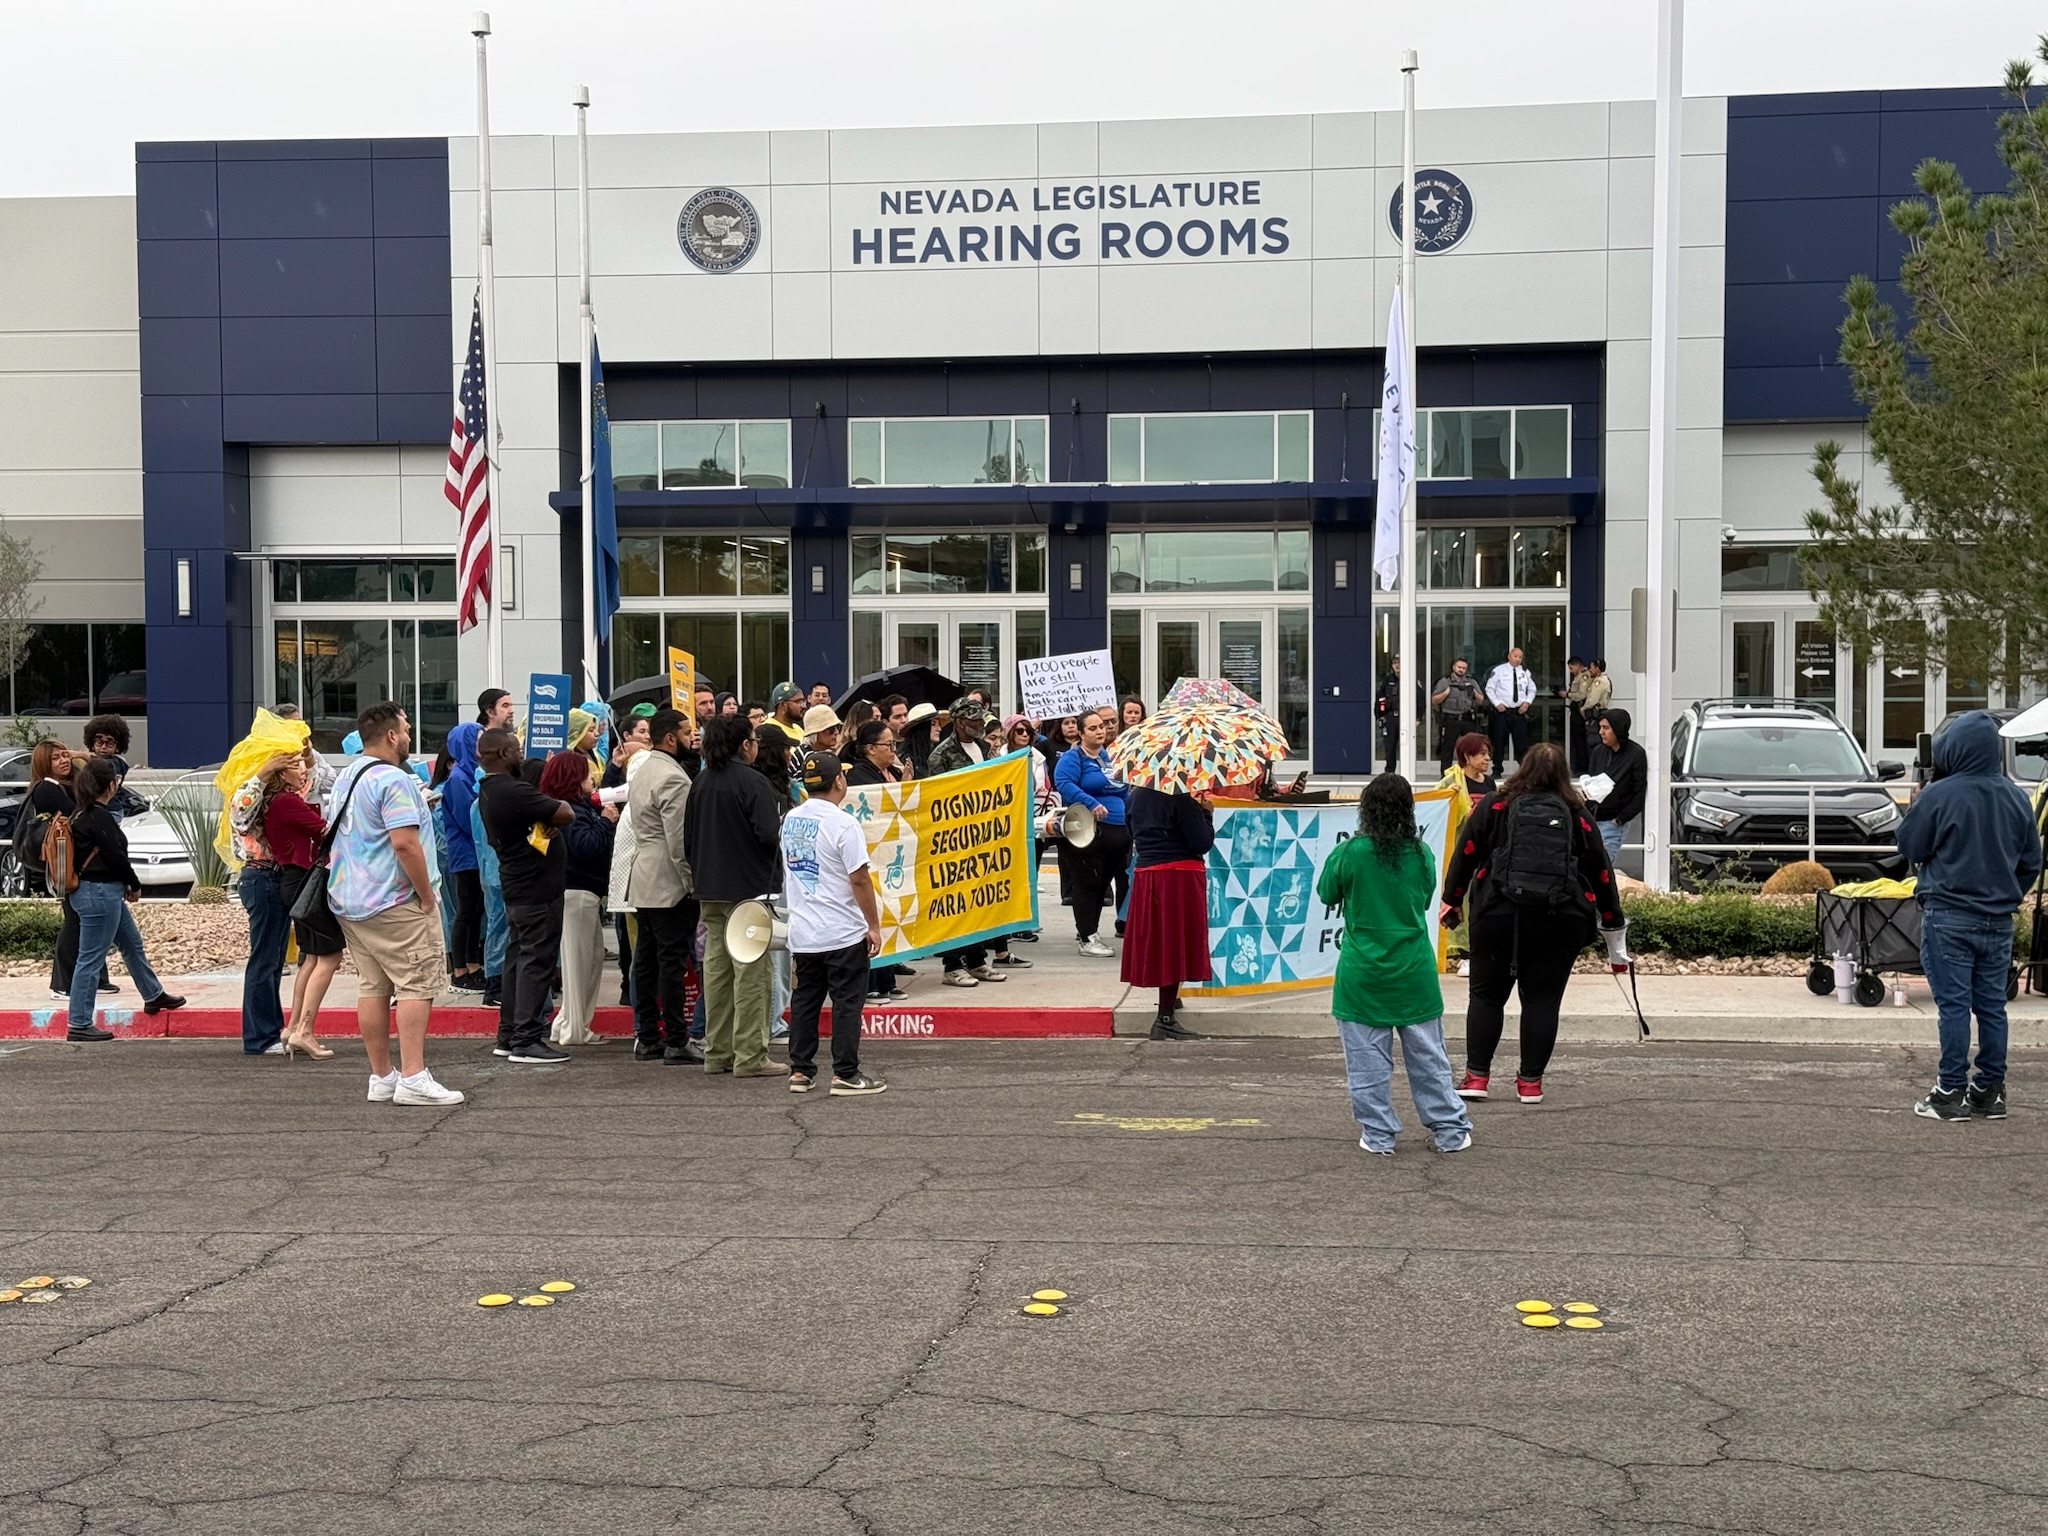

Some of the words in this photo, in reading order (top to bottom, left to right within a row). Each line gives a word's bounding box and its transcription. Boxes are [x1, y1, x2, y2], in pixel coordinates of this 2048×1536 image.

[1415, 180, 1431, 193] ATTLE
[1433, 180, 1450, 193] BORN
[880, 188, 1018, 214] NEVADA
[1033, 181, 1260, 212] LEGISLATURE
[1418, 215, 1445, 225] NEVADA
[852, 222, 1081, 265] HEARING
[1101, 217, 1290, 258] ROOMS
[702, 261, 734, 270] NEVADA
[1024, 660, 1059, 676] 1,200
[1061, 655, 1100, 671] people
[1025, 676, 1046, 687] are
[1051, 671, 1078, 685] still
[1078, 684, 1103, 695] from
[541, 727, 555, 735] SOLO
[930, 783, 1014, 823] DIGNIDAD
[930, 814, 1011, 856] SEGURIDAD
[929, 846, 1012, 890] LIBERTAD
[928, 891, 967, 921] PARA
[970, 879, 1011, 909] TODES
[860, 1014, 935, 1035] ARKING
